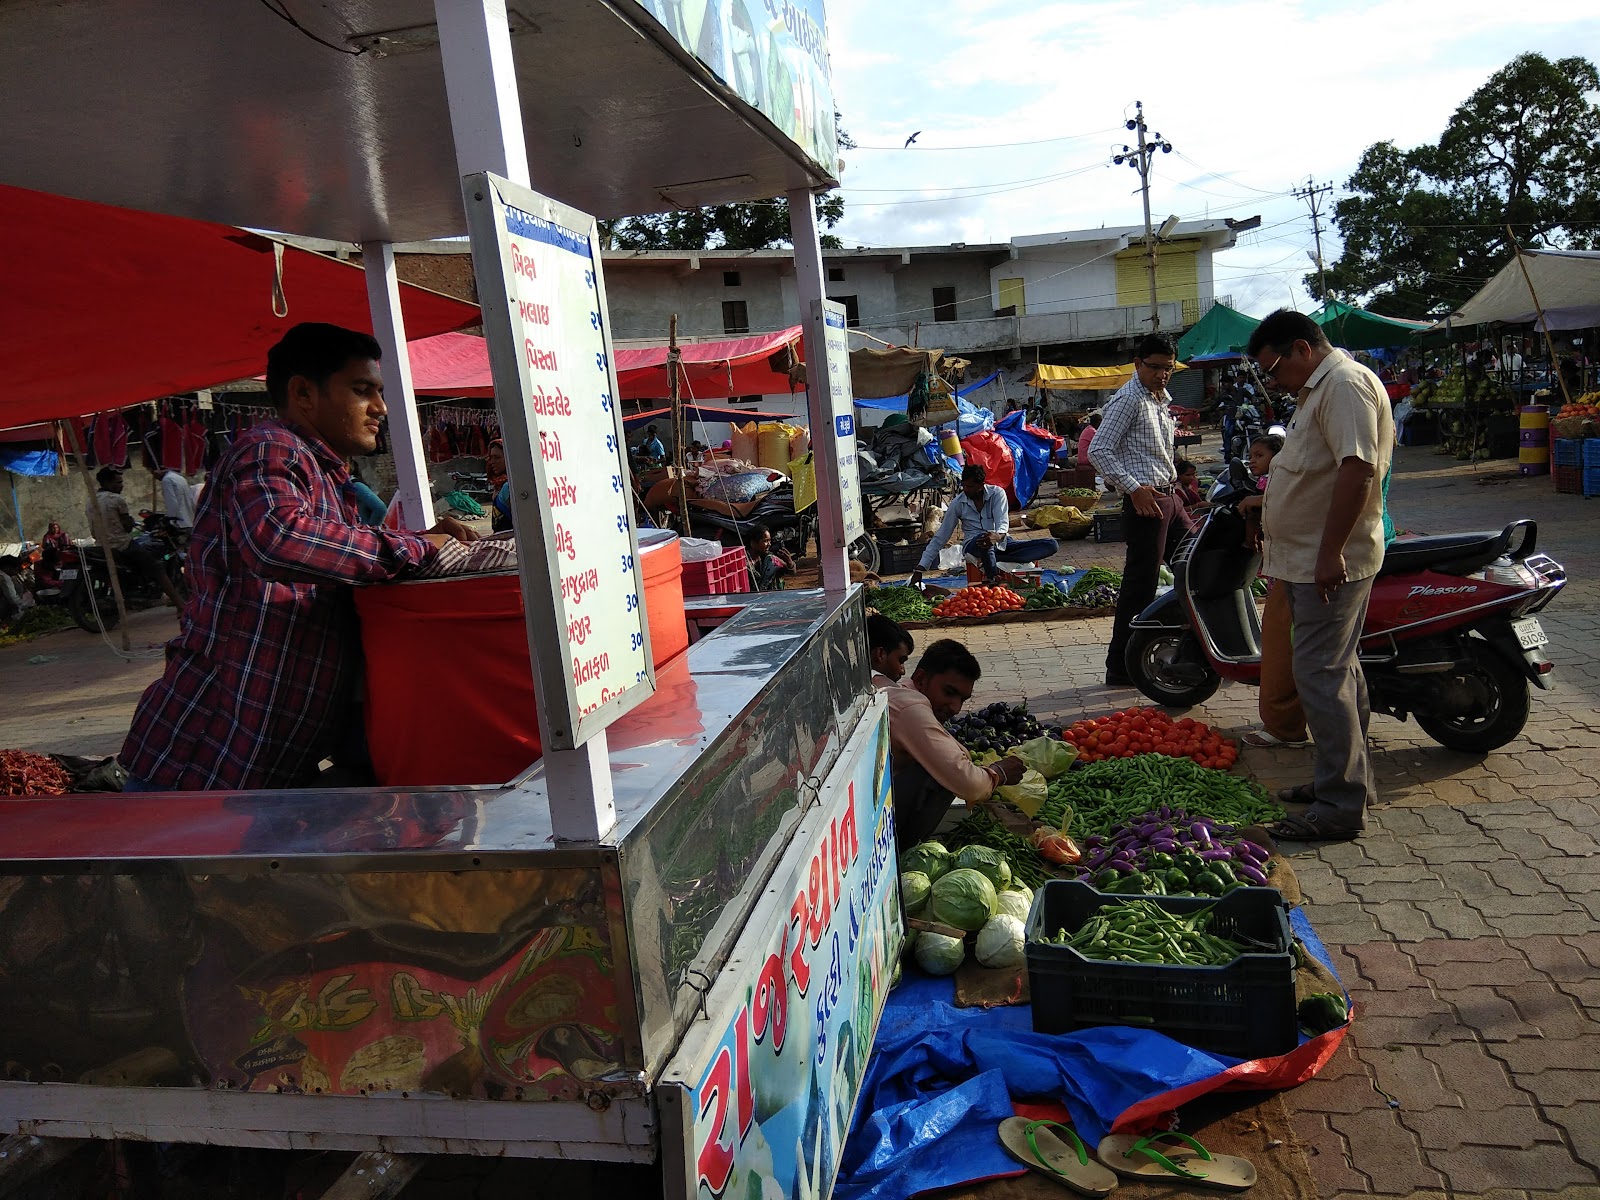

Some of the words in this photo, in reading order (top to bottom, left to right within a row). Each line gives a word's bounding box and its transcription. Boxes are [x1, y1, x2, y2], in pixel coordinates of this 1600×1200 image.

[585, 269, 597, 289] ૨
[525, 338, 558, 372] પિસ્તા
[533, 385, 572, 417] ચોકલેટ
[1407, 584, 1478, 599] Pleasure
[697, 780, 860, 1198] રાજસ્થાન
[815, 930, 842, 1066] કુલ્ફી
